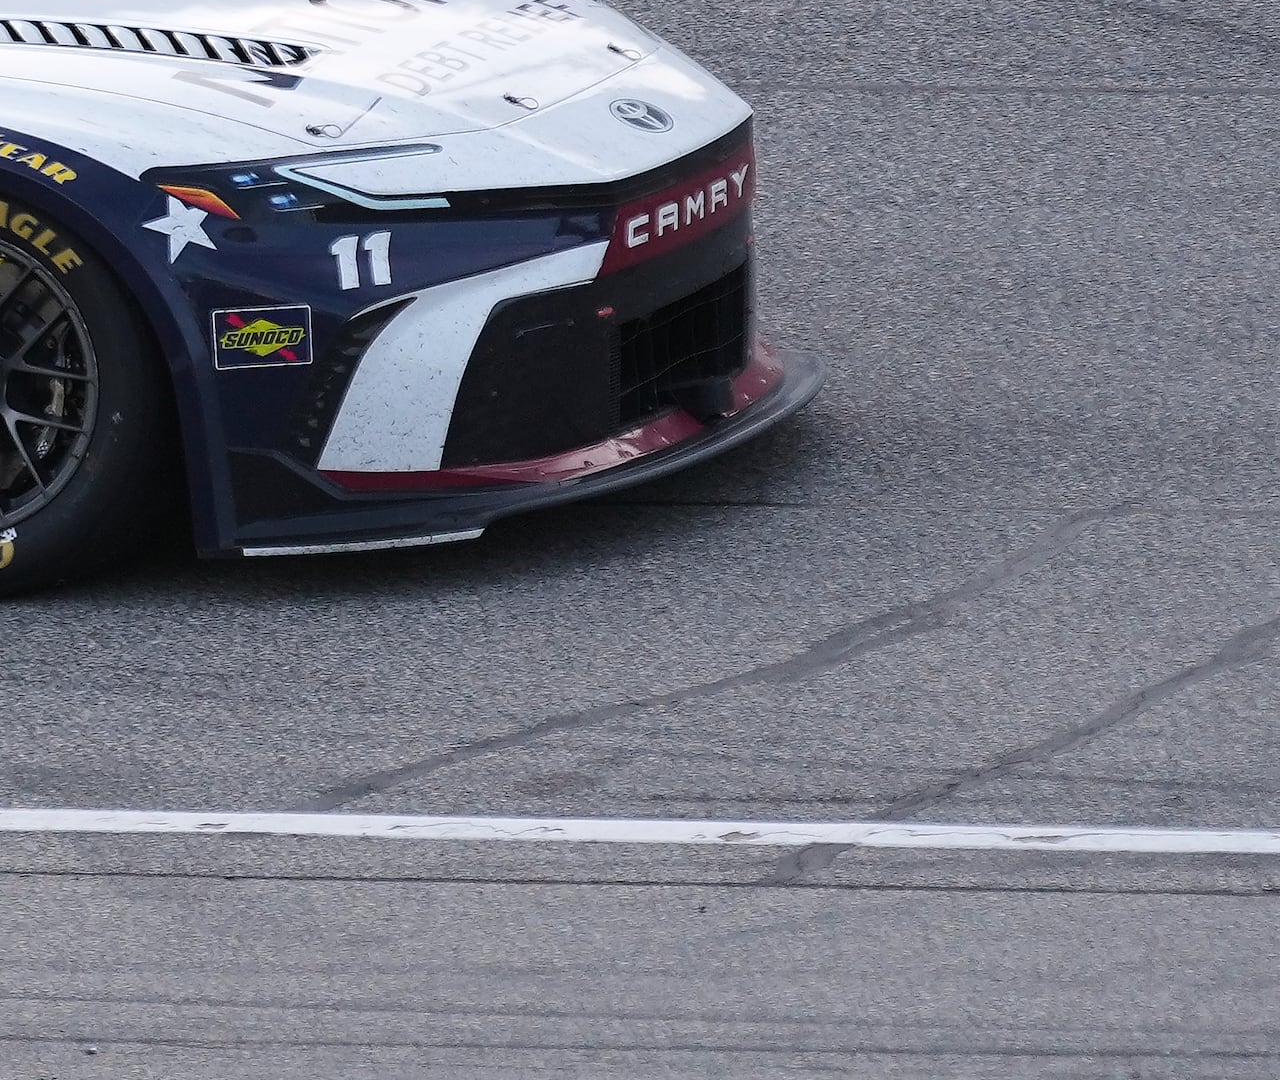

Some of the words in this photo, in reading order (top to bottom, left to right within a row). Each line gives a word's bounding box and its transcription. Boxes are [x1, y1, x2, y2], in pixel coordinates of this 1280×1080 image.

[375, 41, 488, 97] DEBT
[627, 164, 750, 249] CAMRY
[331, 230, 392, 291] 11
[224, 328, 303, 348] SUNOCO
